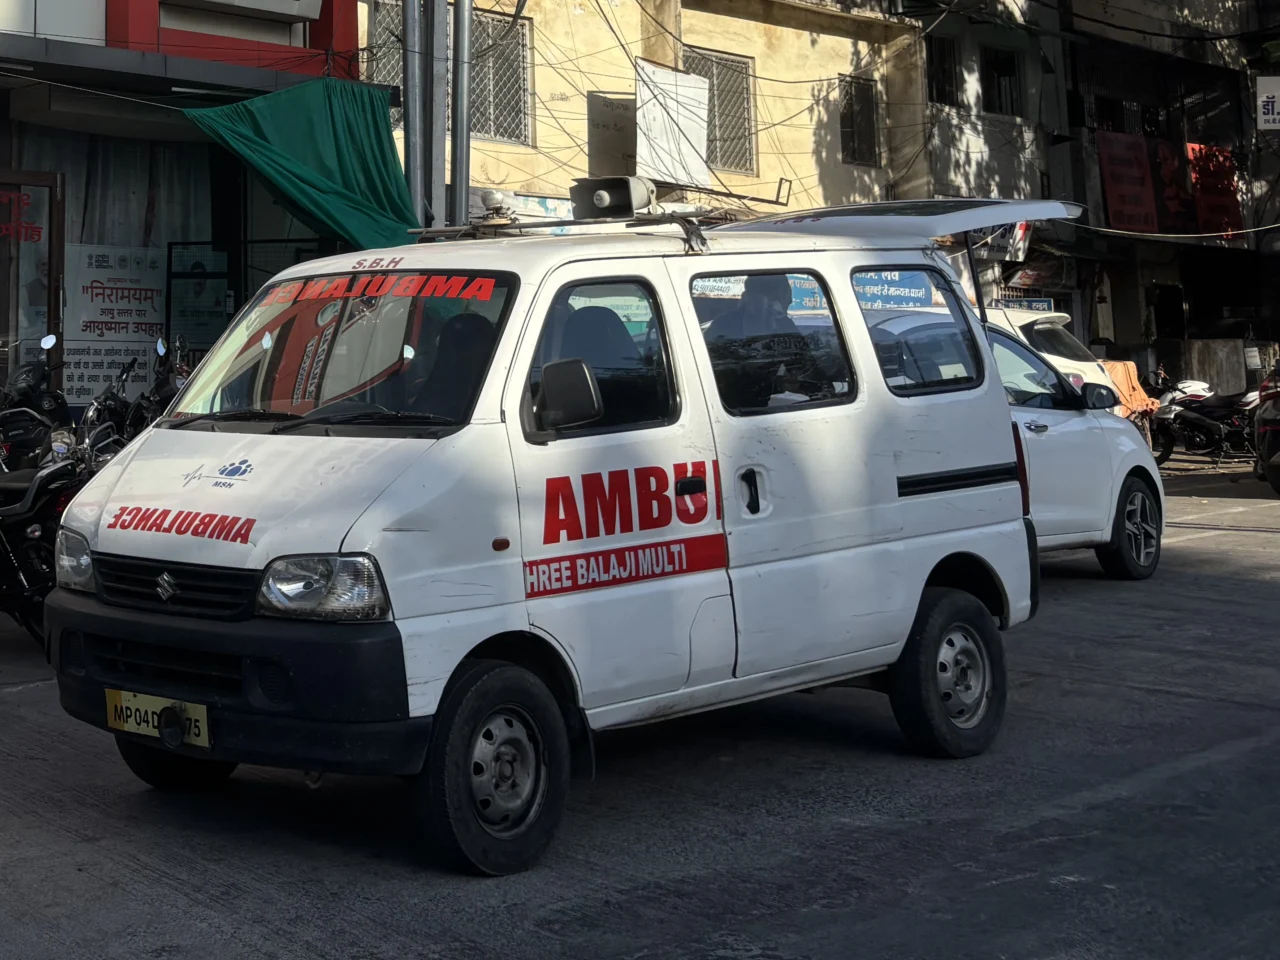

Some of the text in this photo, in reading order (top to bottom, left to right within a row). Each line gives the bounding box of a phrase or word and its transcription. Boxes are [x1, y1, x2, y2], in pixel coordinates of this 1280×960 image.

[352, 257, 404, 270] S.B.H
[99, 308, 147, 320] आयु सत्तर पार
[81, 320, 165, 338] आयुष्मान उपहार
[526, 543, 687, 593] HREE BALAJI MULTI
[114, 703, 201, 738] MP04D75
